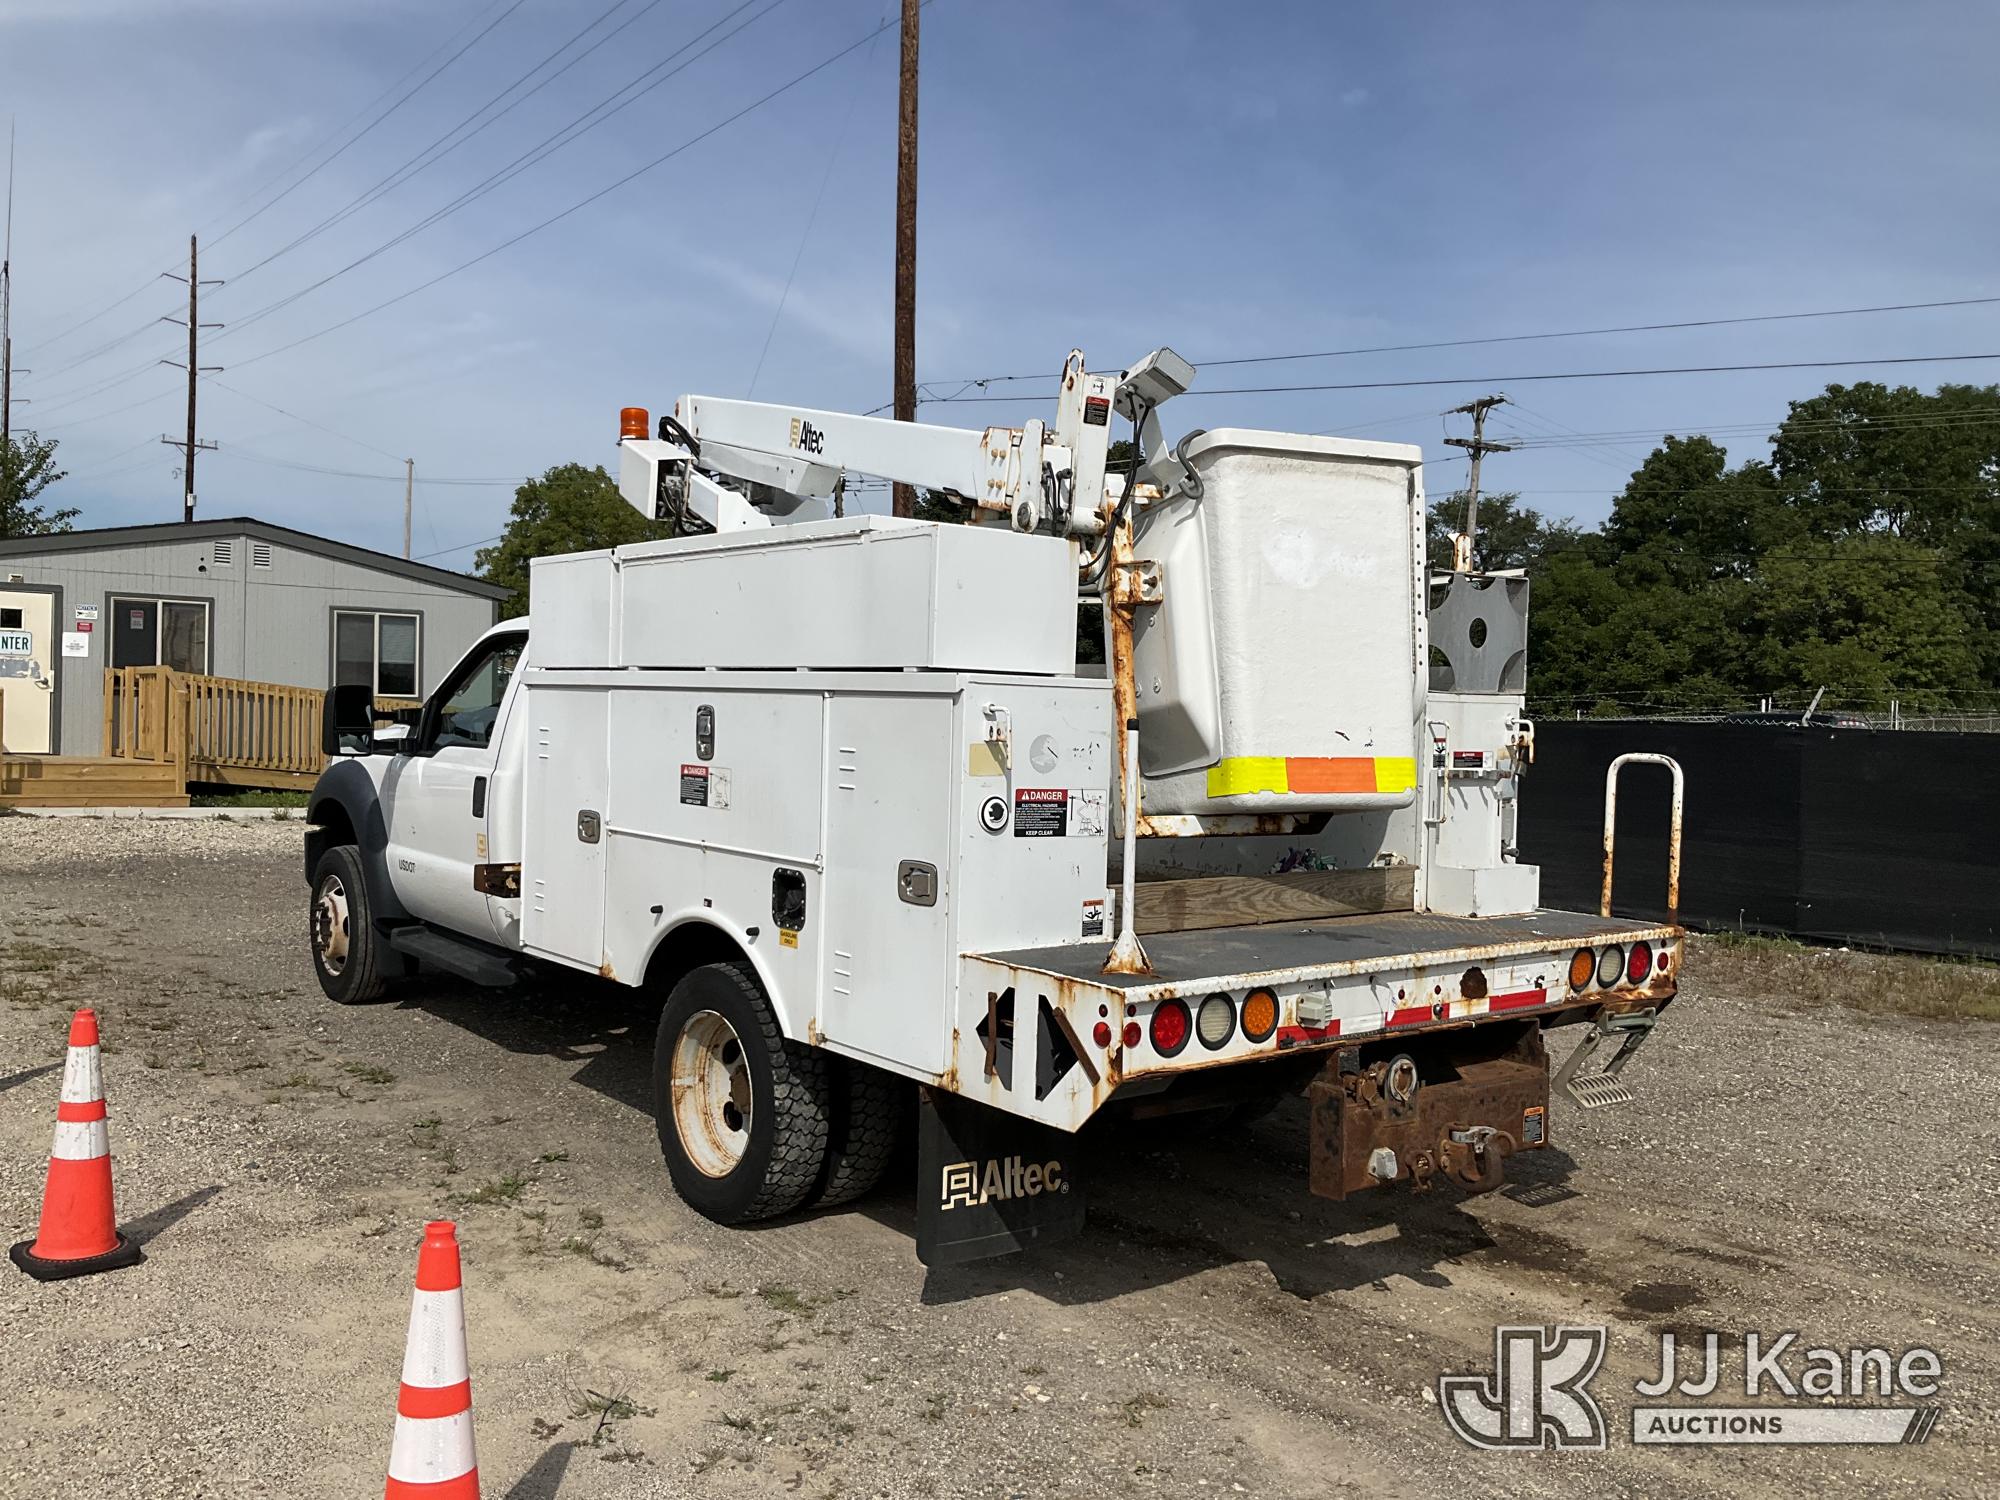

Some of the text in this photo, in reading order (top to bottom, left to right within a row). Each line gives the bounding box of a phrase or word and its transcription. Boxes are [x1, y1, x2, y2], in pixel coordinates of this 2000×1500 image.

[798, 420, 824, 454] Altec
[1, 635, 29, 650] NTER
[688, 767, 707, 776] DANGER
[1030, 791, 1063, 800] DANGER
